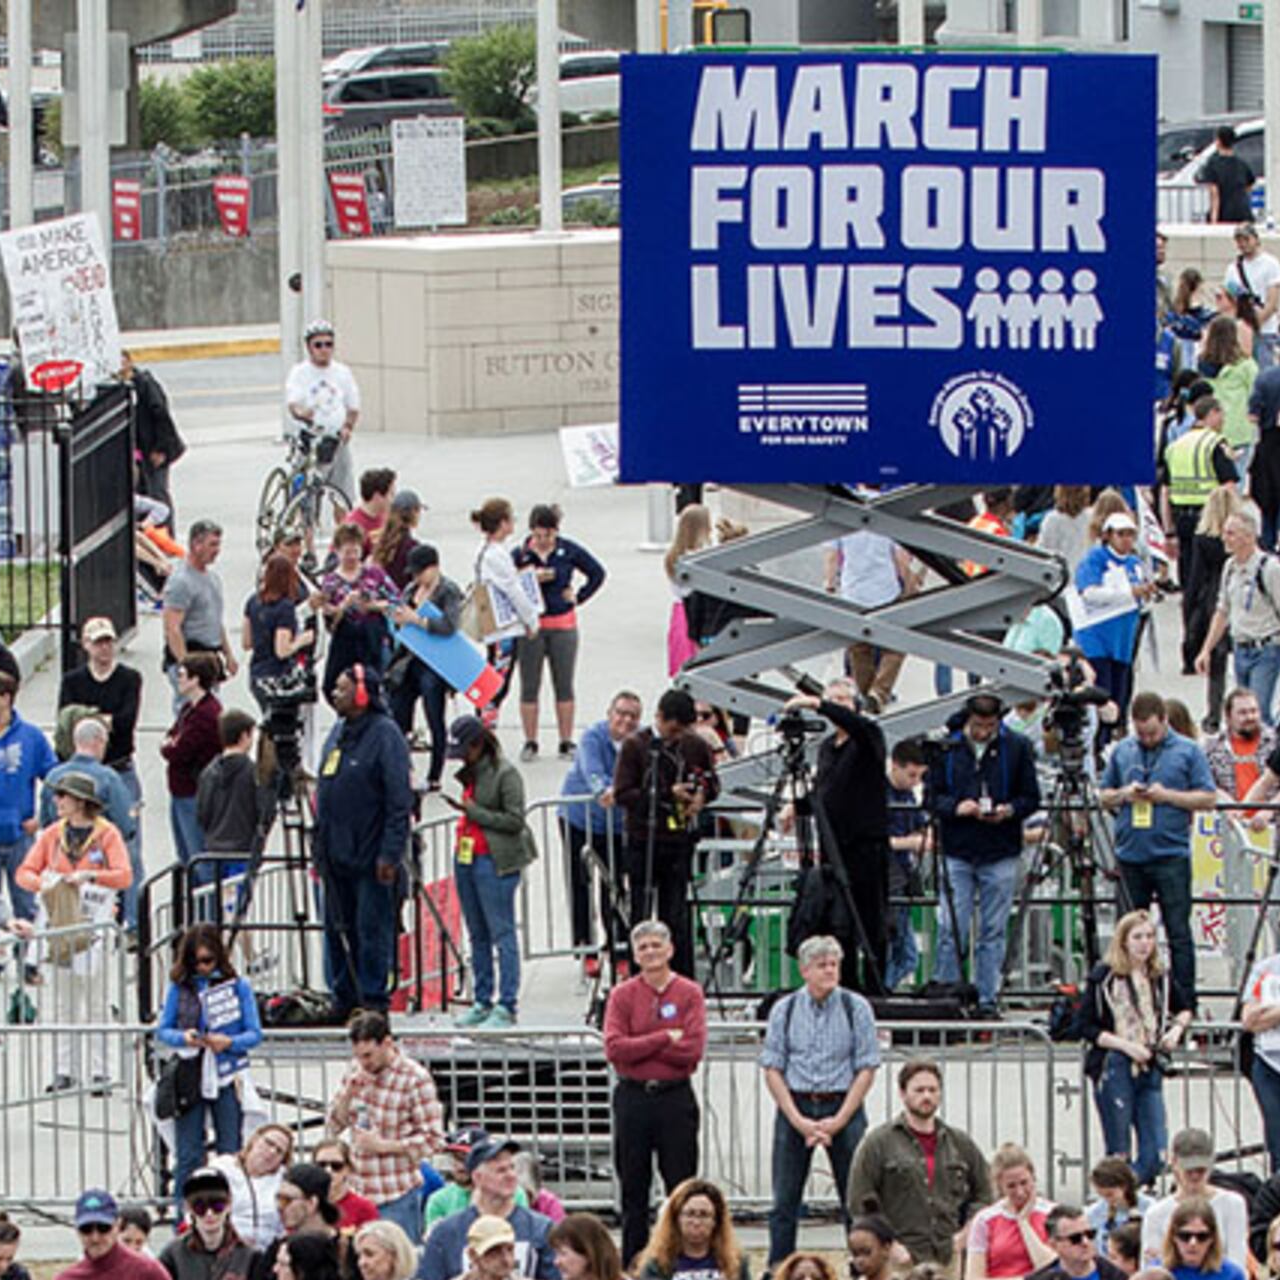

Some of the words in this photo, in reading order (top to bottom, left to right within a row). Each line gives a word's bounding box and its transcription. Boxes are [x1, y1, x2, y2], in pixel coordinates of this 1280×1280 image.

[691, 63, 1047, 151] MARCH
[39, 221, 87, 249] MAKE
[691, 165, 884, 249] FOR
[902, 165, 1105, 251] OUR
[692, 265, 962, 348] LIVES
[485, 352, 596, 378] BUTTON
[740, 416, 867, 431] EVERYTOWN
